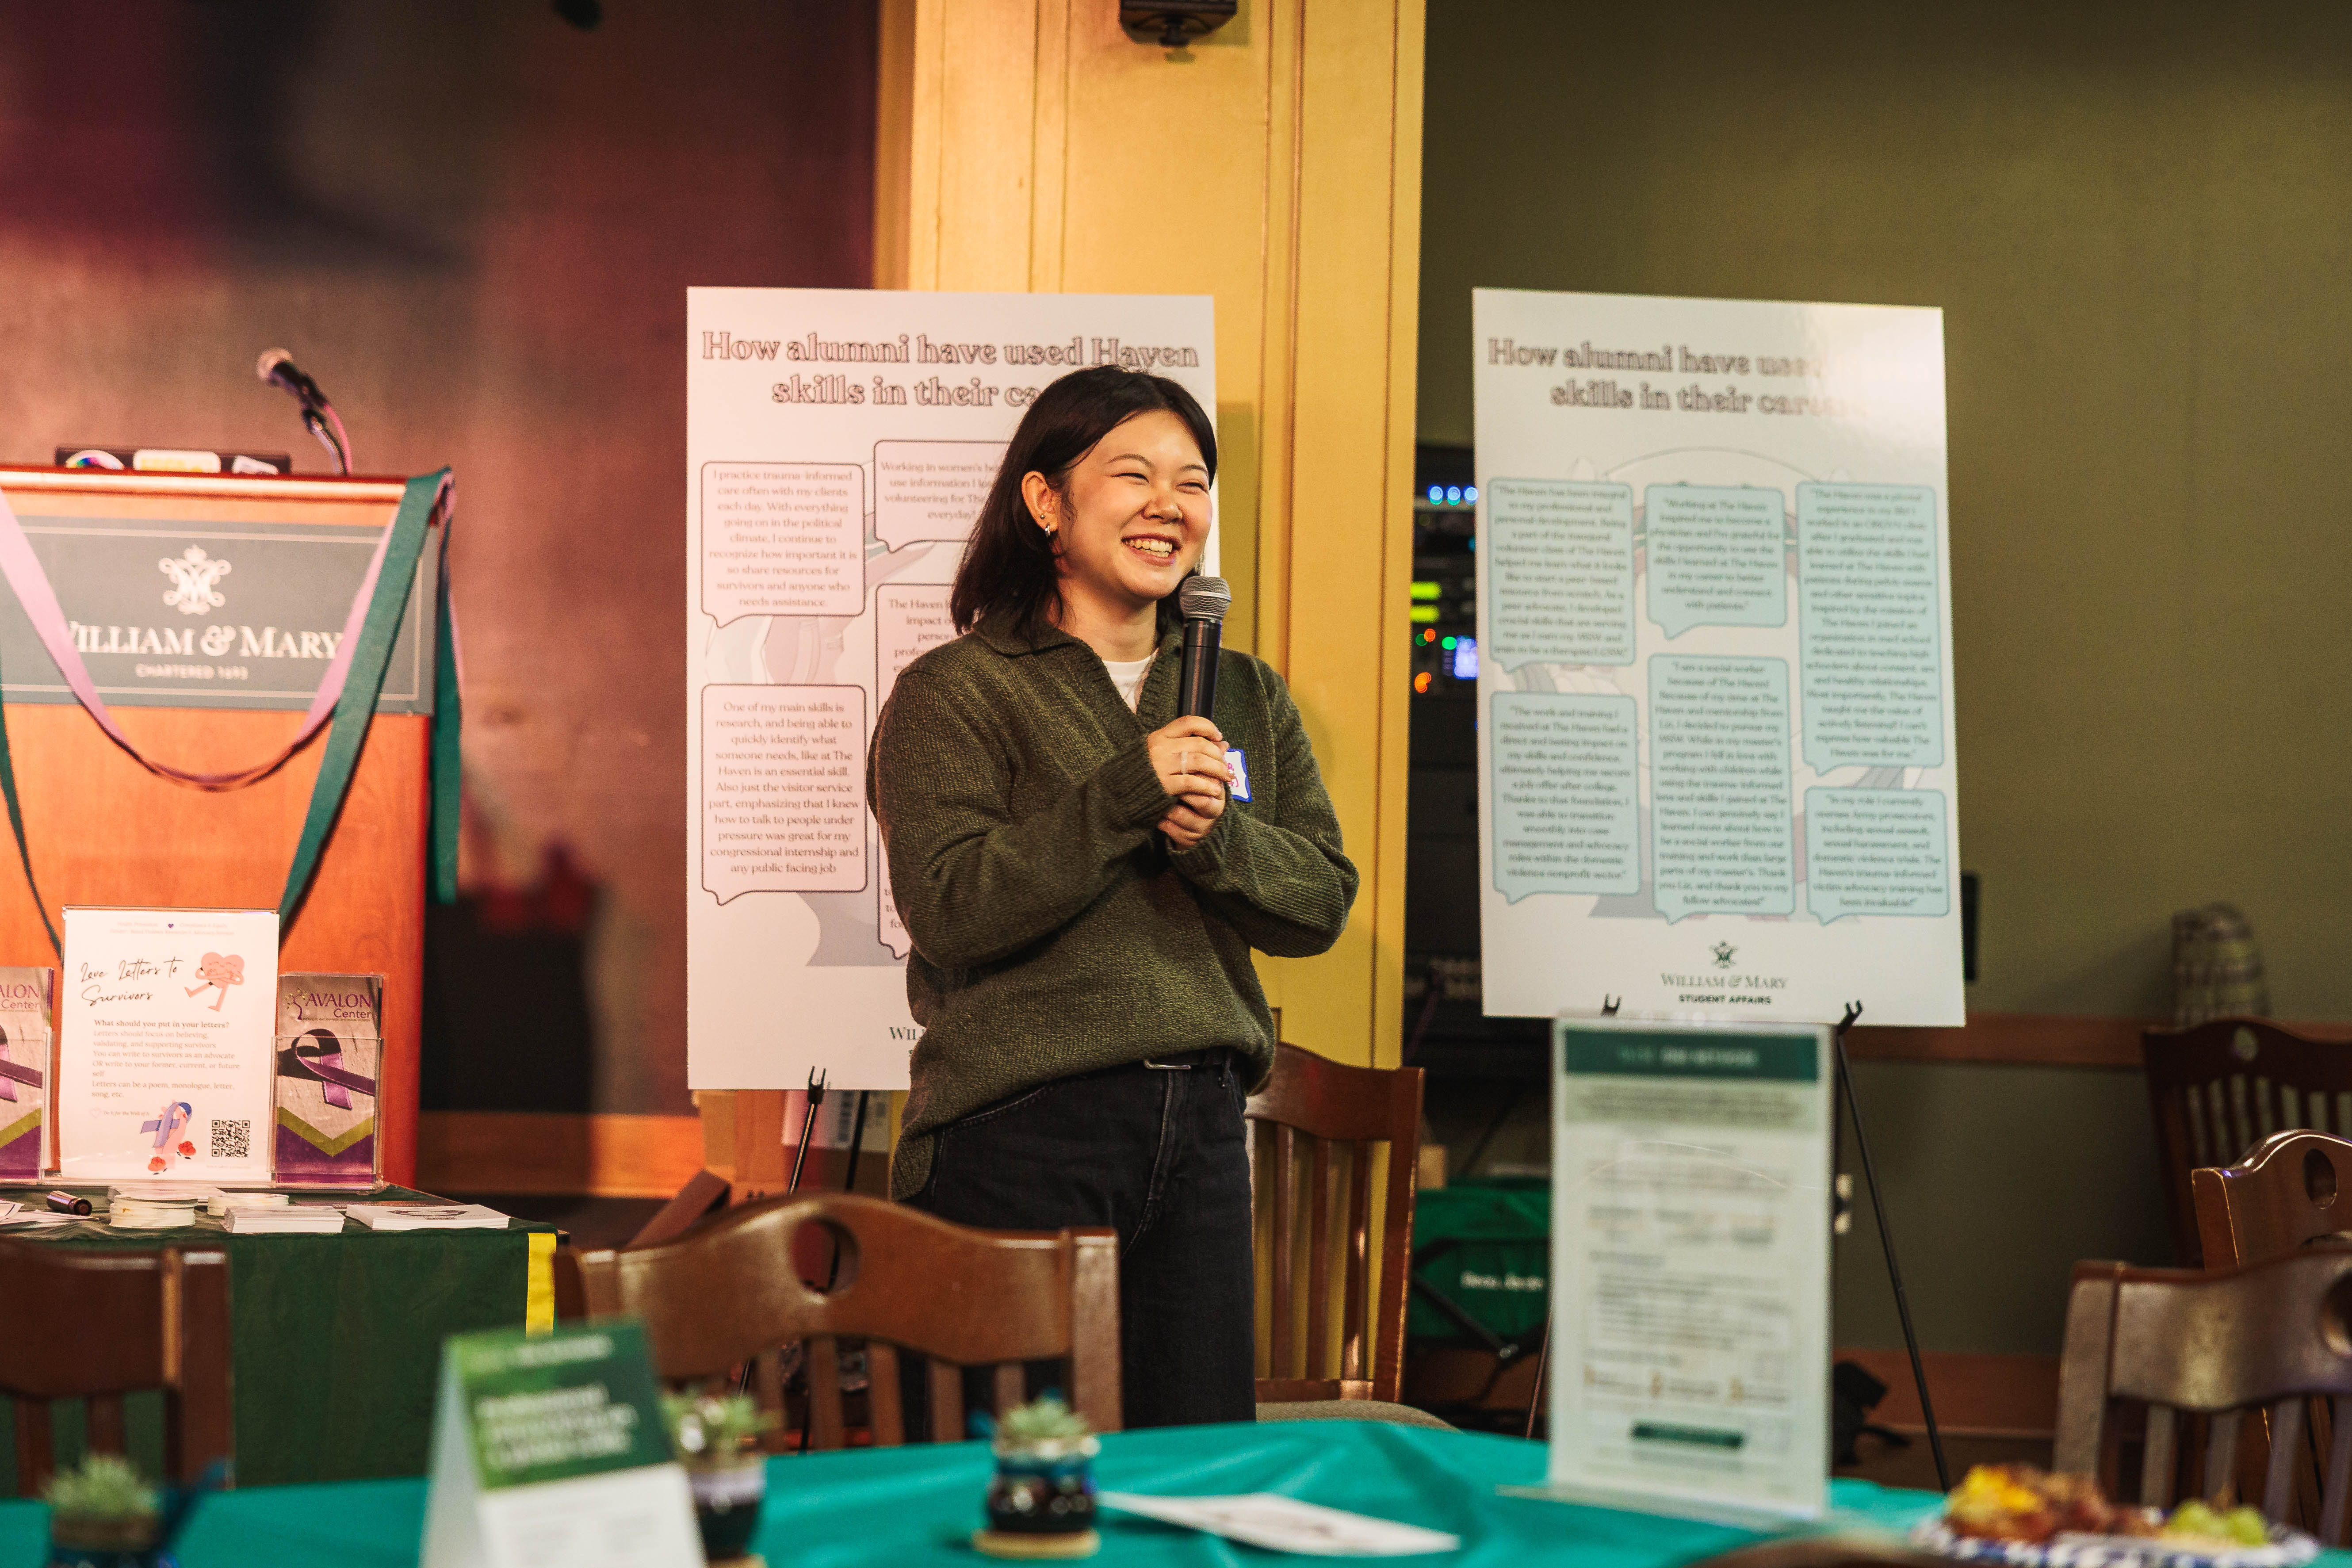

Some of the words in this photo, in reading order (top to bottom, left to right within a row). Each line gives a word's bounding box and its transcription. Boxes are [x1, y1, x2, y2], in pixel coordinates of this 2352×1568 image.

[703, 332, 780, 360] How
[786, 332, 910, 363] alumni
[917, 334, 997, 365] have
[1003, 336, 1083, 366] used
[1091, 338, 1199, 368] Haven
[1488, 338, 1558, 367] How
[1562, 340, 1673, 372] alumni
[1678, 345, 1750, 375] have
[772, 373, 865, 405] skills
[872, 375, 907, 405] in
[914, 376, 999, 407] their
[1550, 378, 1634, 409] skills
[1639, 382, 1671, 411] in
[1676, 383, 1753, 414] their
[69, 621, 194, 655] ILLIAM
[199, 625, 237, 657] &
[239, 626, 344, 659] MARY
[723, 703, 745, 711] One
[747, 702, 758, 711] of
[761, 705, 777, 713] my
[779, 703, 806, 712] main
[807, 702, 834, 712] skills
[835, 703, 845, 712] is
[765, 719, 784, 728] and
[786, 719, 815, 730] being
[817, 719, 839, 729] able
[731, 734, 768, 746] quickly
[770, 734, 810, 746] identify
[811, 734, 837, 744] what
[800, 750, 818, 760] like
[833, 750, 853, 761] The
[719, 767, 751, 775] Haven
[779, 767, 825, 776] essential
[716, 783, 738, 791] Also
[741, 784, 760, 793] just
[762, 783, 779, 792] the
[781, 783, 815, 792] visitor
[815, 783, 853, 792] service
[735, 799, 801, 810] emphasizing
[803, 799, 824, 808] that
[826, 799, 830, 808] I
[832, 799, 860, 809] knew
[752, 815, 771, 824] talk
[786, 815, 821, 826] people
[823, 815, 854, 825] under
[718, 833, 763, 842] pressure
[788, 833, 815, 841] great
[817, 830, 832, 841] for
[834, 834, 851, 843] my
[710, 847, 782, 857] congressional
[784, 847, 837, 859] internship
[839, 847, 859, 857] and
[730, 865, 749, 874] any
[751, 863, 783, 875] public
[785, 863, 818, 874] facing
[819, 863, 837, 874] job
[80, 962, 108, 983] Love
[119, 959, 161, 981] Letters
[164, 956, 184, 978] to
[1660, 972, 1725, 988] WILLIAM
[1727, 975, 1742, 989] &
[1745, 975, 1790, 989] MARY
[81, 984, 153, 1007] Survivors
[305, 993, 372, 1008] AVALON
[1679, 994, 1726, 1003] STUDENT
[1729, 995, 1772, 1004] AFFAIRS
[1, 999, 38, 1009] Center
[333, 1008, 371, 1018] Center
